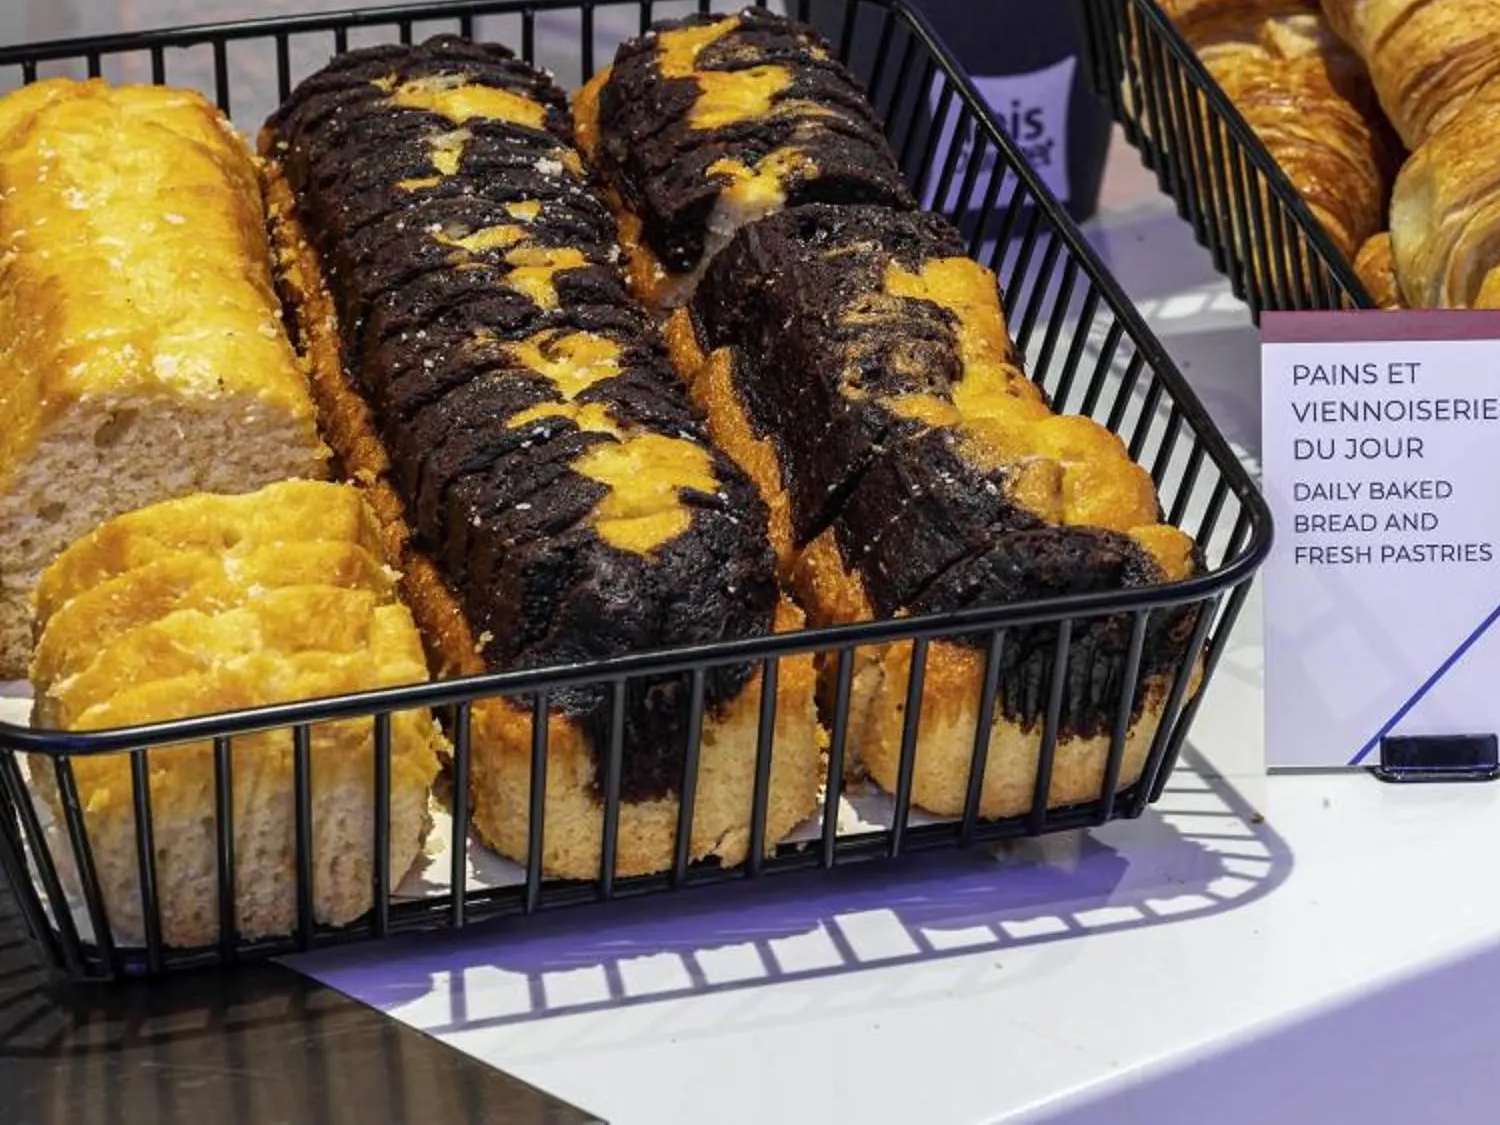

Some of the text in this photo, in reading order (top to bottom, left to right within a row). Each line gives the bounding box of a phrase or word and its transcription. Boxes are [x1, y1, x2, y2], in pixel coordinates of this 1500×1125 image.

[1292, 362, 1421, 386] PAINS ET
[1294, 437, 1424, 460] DU JOUR
[1293, 480, 1453, 502] DAILY BAKED
[1294, 512, 1438, 533] BREAD AND
[1295, 544, 1493, 564] FRESH PASTRIES
